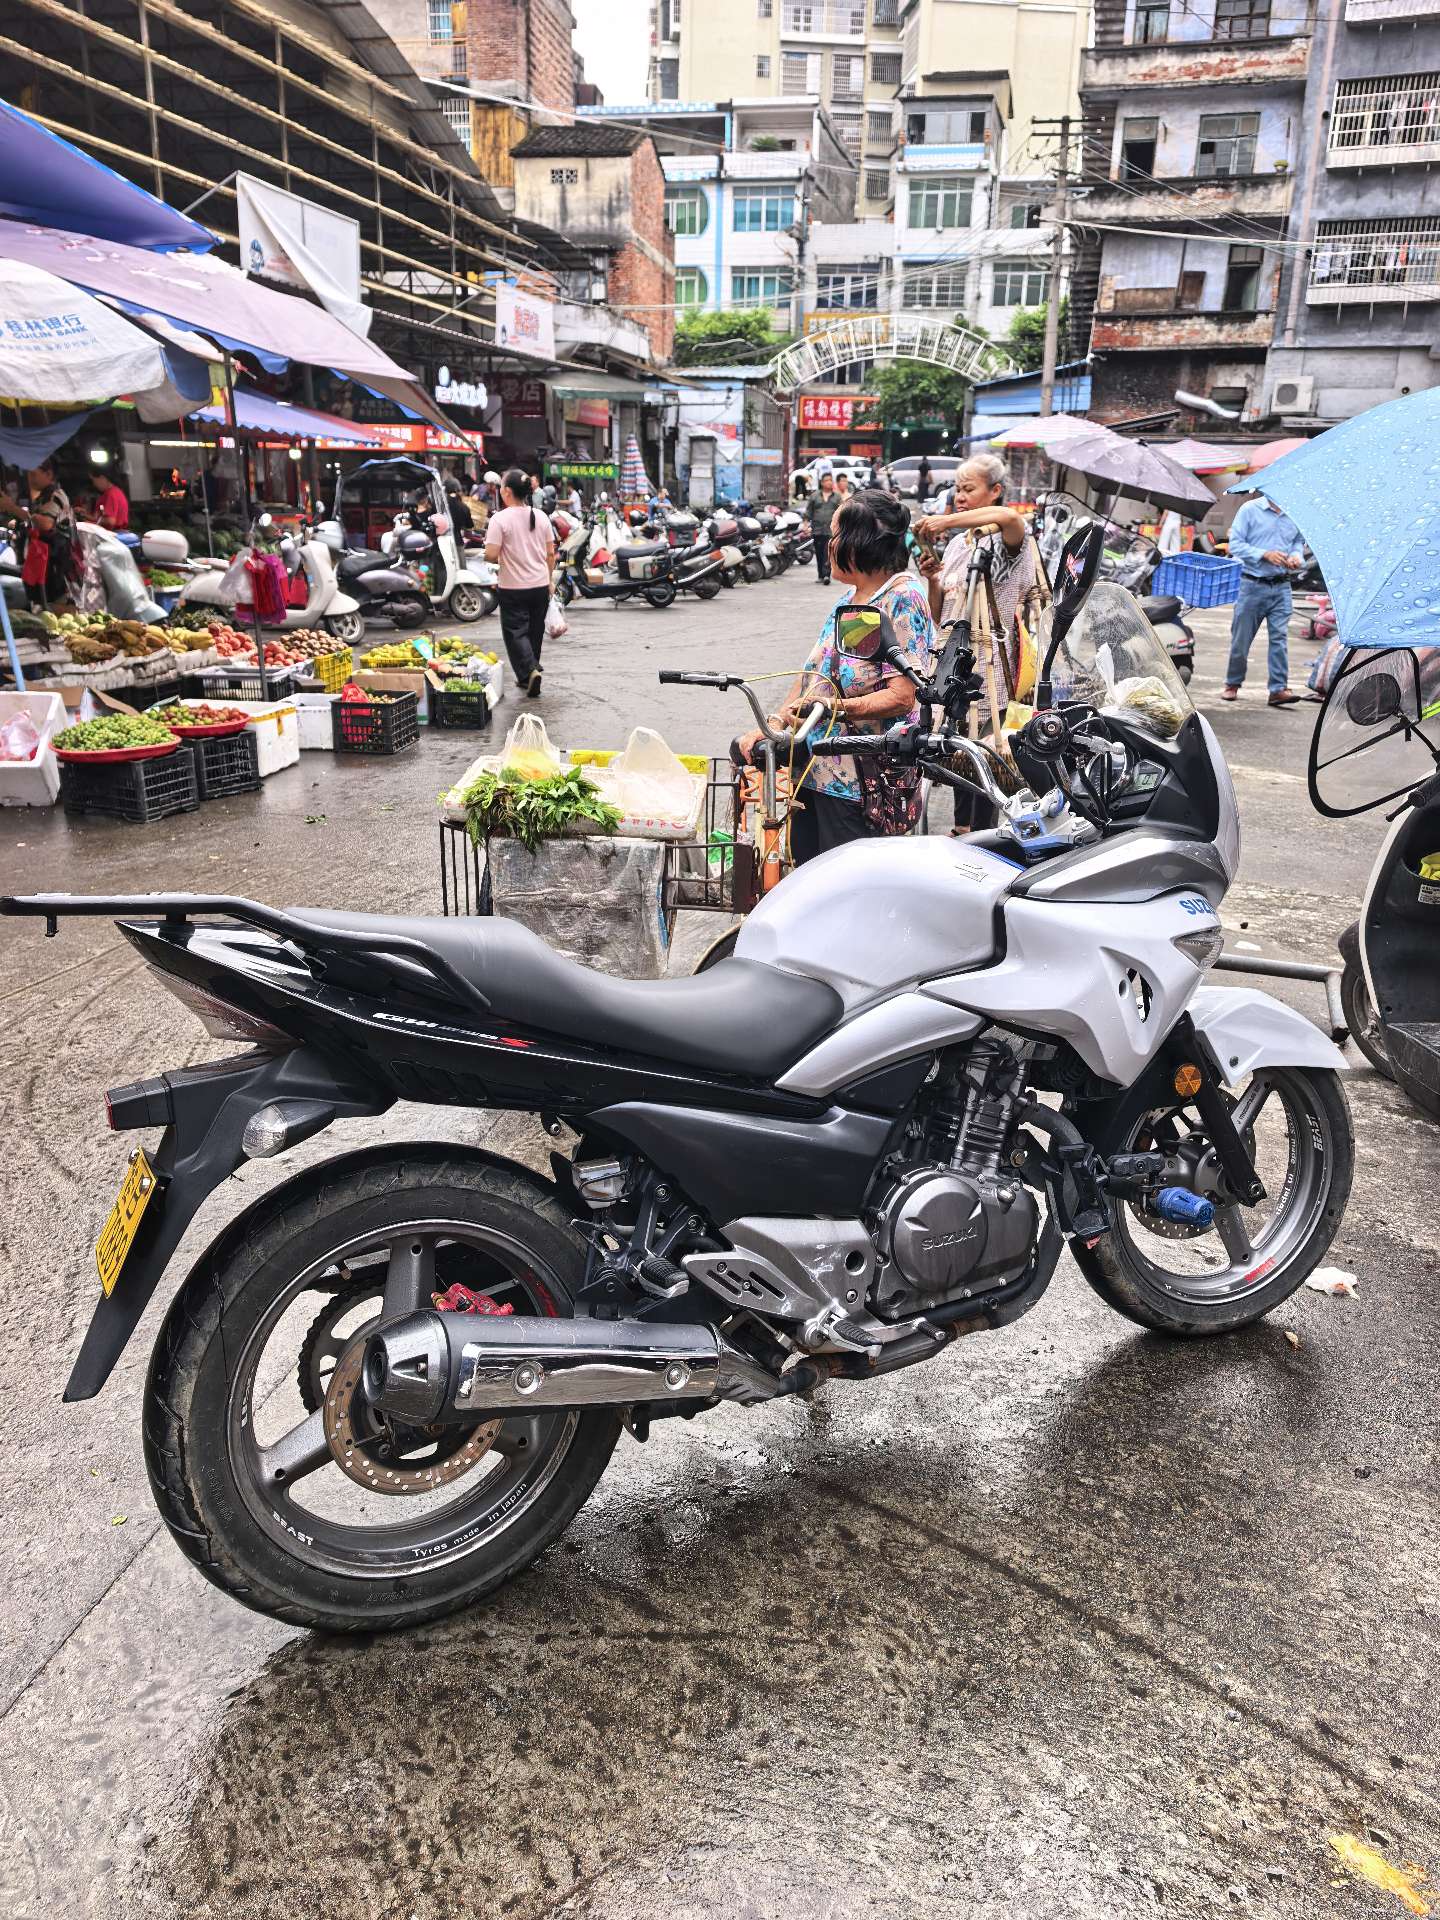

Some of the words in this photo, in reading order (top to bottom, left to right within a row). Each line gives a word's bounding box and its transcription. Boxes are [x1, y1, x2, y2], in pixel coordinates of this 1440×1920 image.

[5, 313, 83, 333] 桂林银行
[13, 330, 53, 340] GUILIN
[56, 325, 89, 337] BANK
[921, 1226, 978, 1251] SUZUKI
[272, 1510, 314, 1546] BEAST
[411, 1542, 449, 1557] Tyres
[452, 1526, 480, 1545] made
[487, 1511, 501, 1523] in
